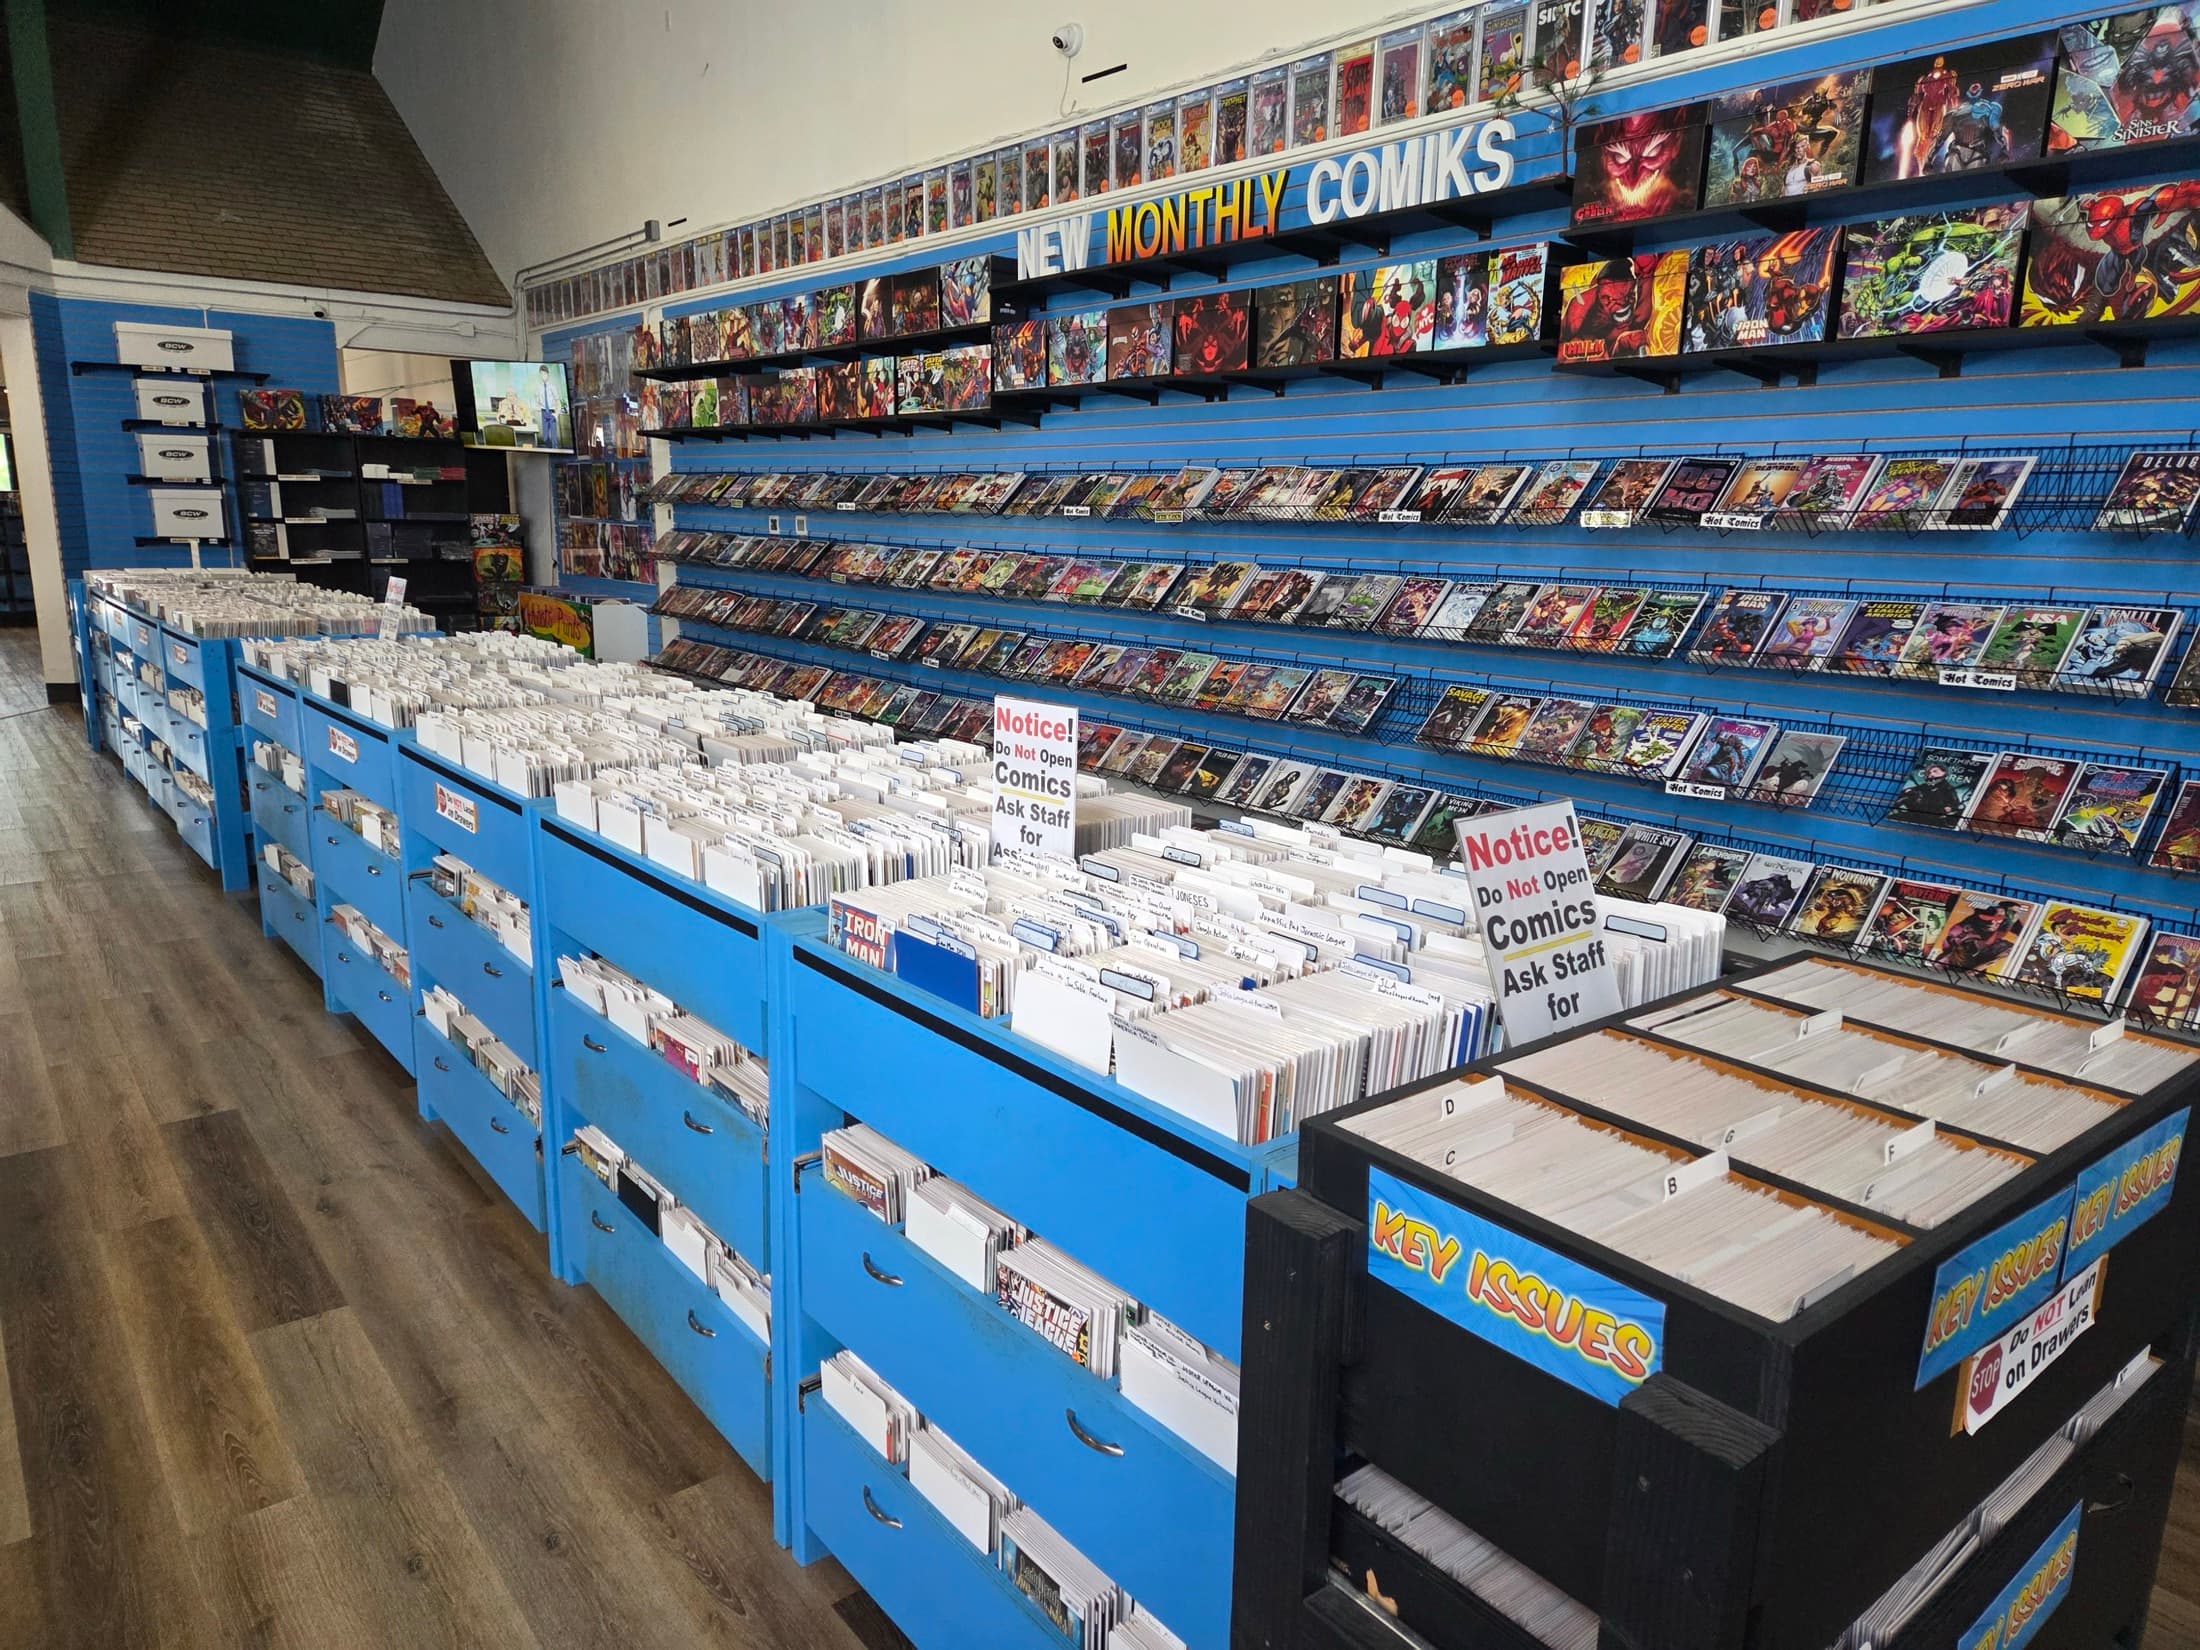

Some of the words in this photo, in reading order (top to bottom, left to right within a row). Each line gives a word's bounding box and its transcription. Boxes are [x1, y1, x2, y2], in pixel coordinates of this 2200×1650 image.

[1017, 215, 1092, 281] NEW
[1106, 169, 1289, 265] MONTHLY
[1307, 119, 1516, 226] COMIKS
[1738, 317, 1768, 330] IRON
[165, 342, 187, 350] BCW
[1736, 328, 1767, 342] MAN
[1562, 338, 1605, 361] HULK
[160, 397, 183, 405] BCW
[1704, 515, 1723, 526] Hot
[1728, 517, 1760, 529] Comics
[1736, 600, 1767, 609] MAN
[1739, 594, 1771, 602] IRON
[2024, 613, 2069, 625] JSA
[2105, 609, 2162, 633] KNULL
[1945, 674, 1967, 684] Hot
[1972, 674, 2012, 688] Comics
[1447, 687, 1487, 702] SAVAGE
[996, 706, 1073, 743] Notice!
[1656, 714, 1688, 725] SILVER
[995, 740, 1011, 756] Do
[1014, 743, 1036, 761] Not
[1040, 749, 1072, 768] Open
[1927, 754, 1981, 767] SOMETHING
[995, 761, 1071, 798] Comics
[1671, 783, 1687, 793] Hot
[1691, 784, 1723, 798] Comics
[455, 810, 473, 831] Drawers
[995, 795, 1025, 819] Ask
[1030, 803, 1070, 829] Staff
[1020, 825, 1042, 847] for
[1465, 815, 1580, 872] Notice!
[1634, 830, 1660, 843] WHITE
[1660, 834, 1678, 848] SKY
[1477, 886, 1502, 908] Do
[1507, 875, 1541, 900] Not
[1544, 867, 1588, 893] Open
[1831, 868, 1879, 887] WOLVERINE
[843, 911, 887, 950] IRON
[1259, 911, 1287, 929] Jurassic
[1301, 925, 1325, 941] Jurassic
[1326, 933, 1346, 947] League
[1486, 900, 1597, 951] Comics
[845, 938, 886, 970] MAN
[1503, 961, 1549, 998] Ask
[1552, 939, 1606, 981] Staff
[1378, 978, 1397, 990] JLA
[1548, 991, 1580, 1022] for
[1446, 1099, 1455, 1115] D
[1725, 1129, 1735, 1144] G
[1445, 1150, 1456, 1165] C
[1888, 1144, 1895, 1162] F
[835, 1165, 883, 1199] JUSTICE
[1668, 1177, 1678, 1195] B
[1865, 1184, 1874, 1200] E
[2068, 1177, 2118, 1252] KEY
[2112, 1135, 2182, 1220] ISSUES
[1373, 1201, 1460, 1281] KEY
[1469, 1252, 1653, 1384] ISSUES
[1926, 1270, 1984, 1355] KEY
[1981, 1215, 2067, 1315] ISSUES
[1011, 1279, 1081, 1337] JUSTICE
[2008, 1326, 2030, 1355] Do
[2031, 1294, 2065, 1338] NOT
[2067, 1270, 2097, 1310] Lean
[2005, 1361, 2026, 1391] on
[2030, 1301, 2090, 1368] Drawers
[1971, 1360, 2000, 1399] STOP
[2004, 1529, 2077, 1648] ISSUES
